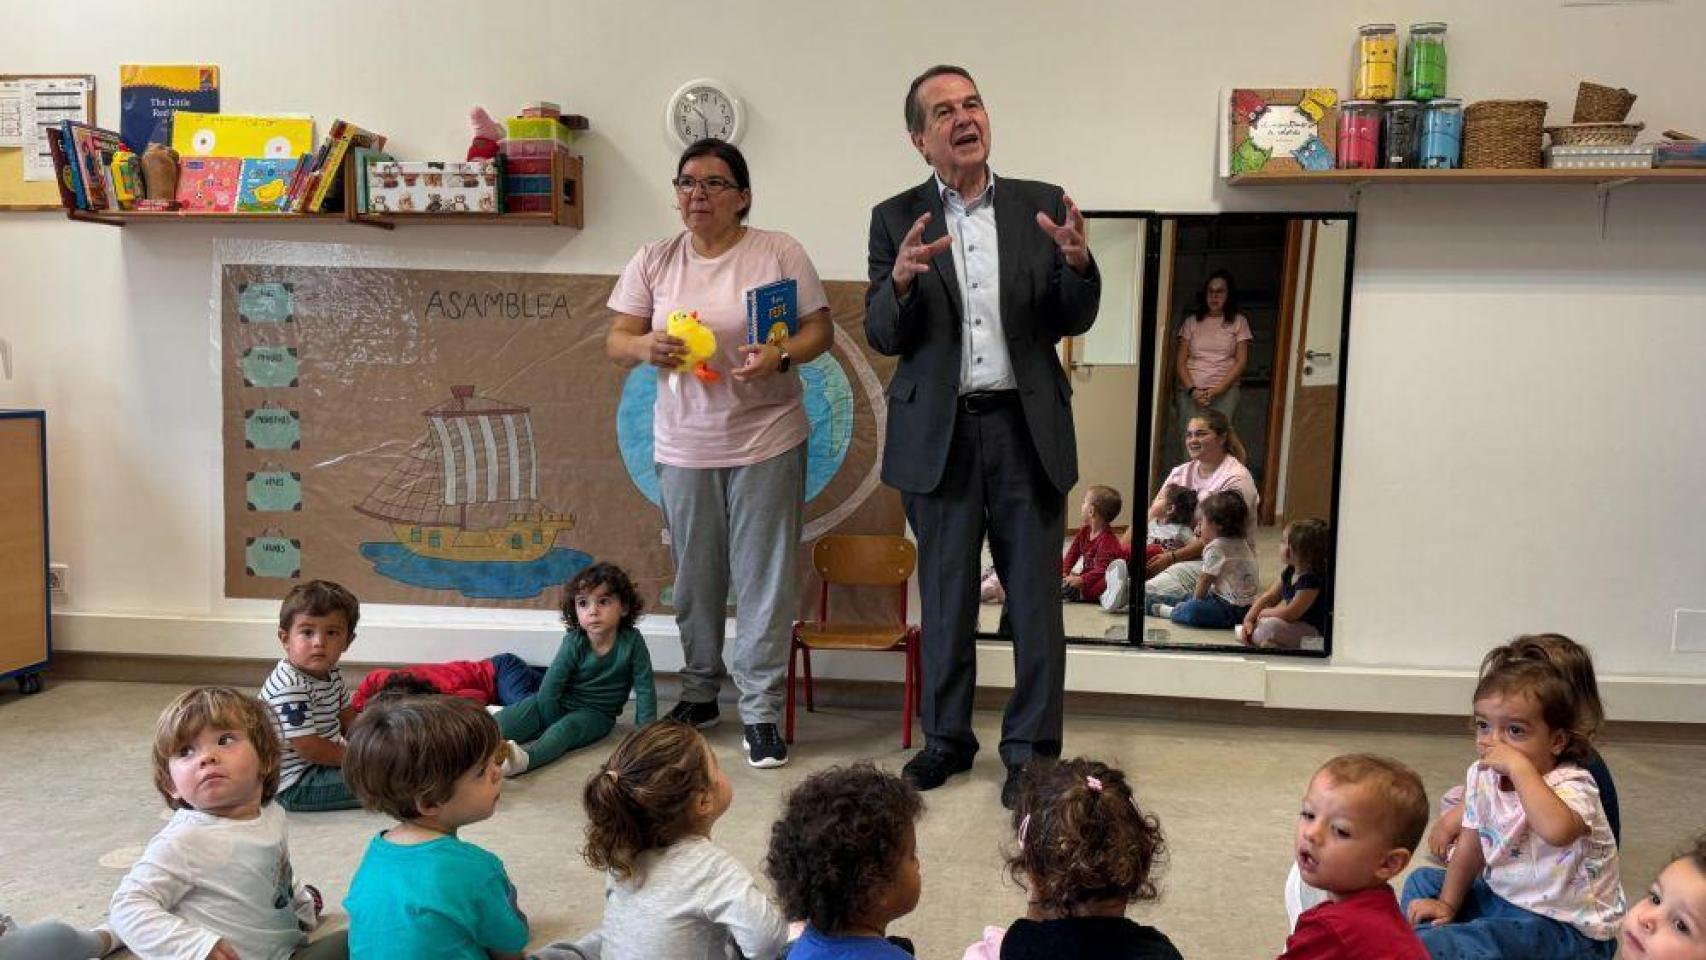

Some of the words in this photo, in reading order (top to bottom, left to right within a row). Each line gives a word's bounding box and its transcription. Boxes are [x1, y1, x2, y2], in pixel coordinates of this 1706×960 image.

[150, 98, 166, 106] The
[168, 98, 191, 107] Little
[152, 108, 170, 117] Red
[425, 290, 571, 320] ASAMBLEA
